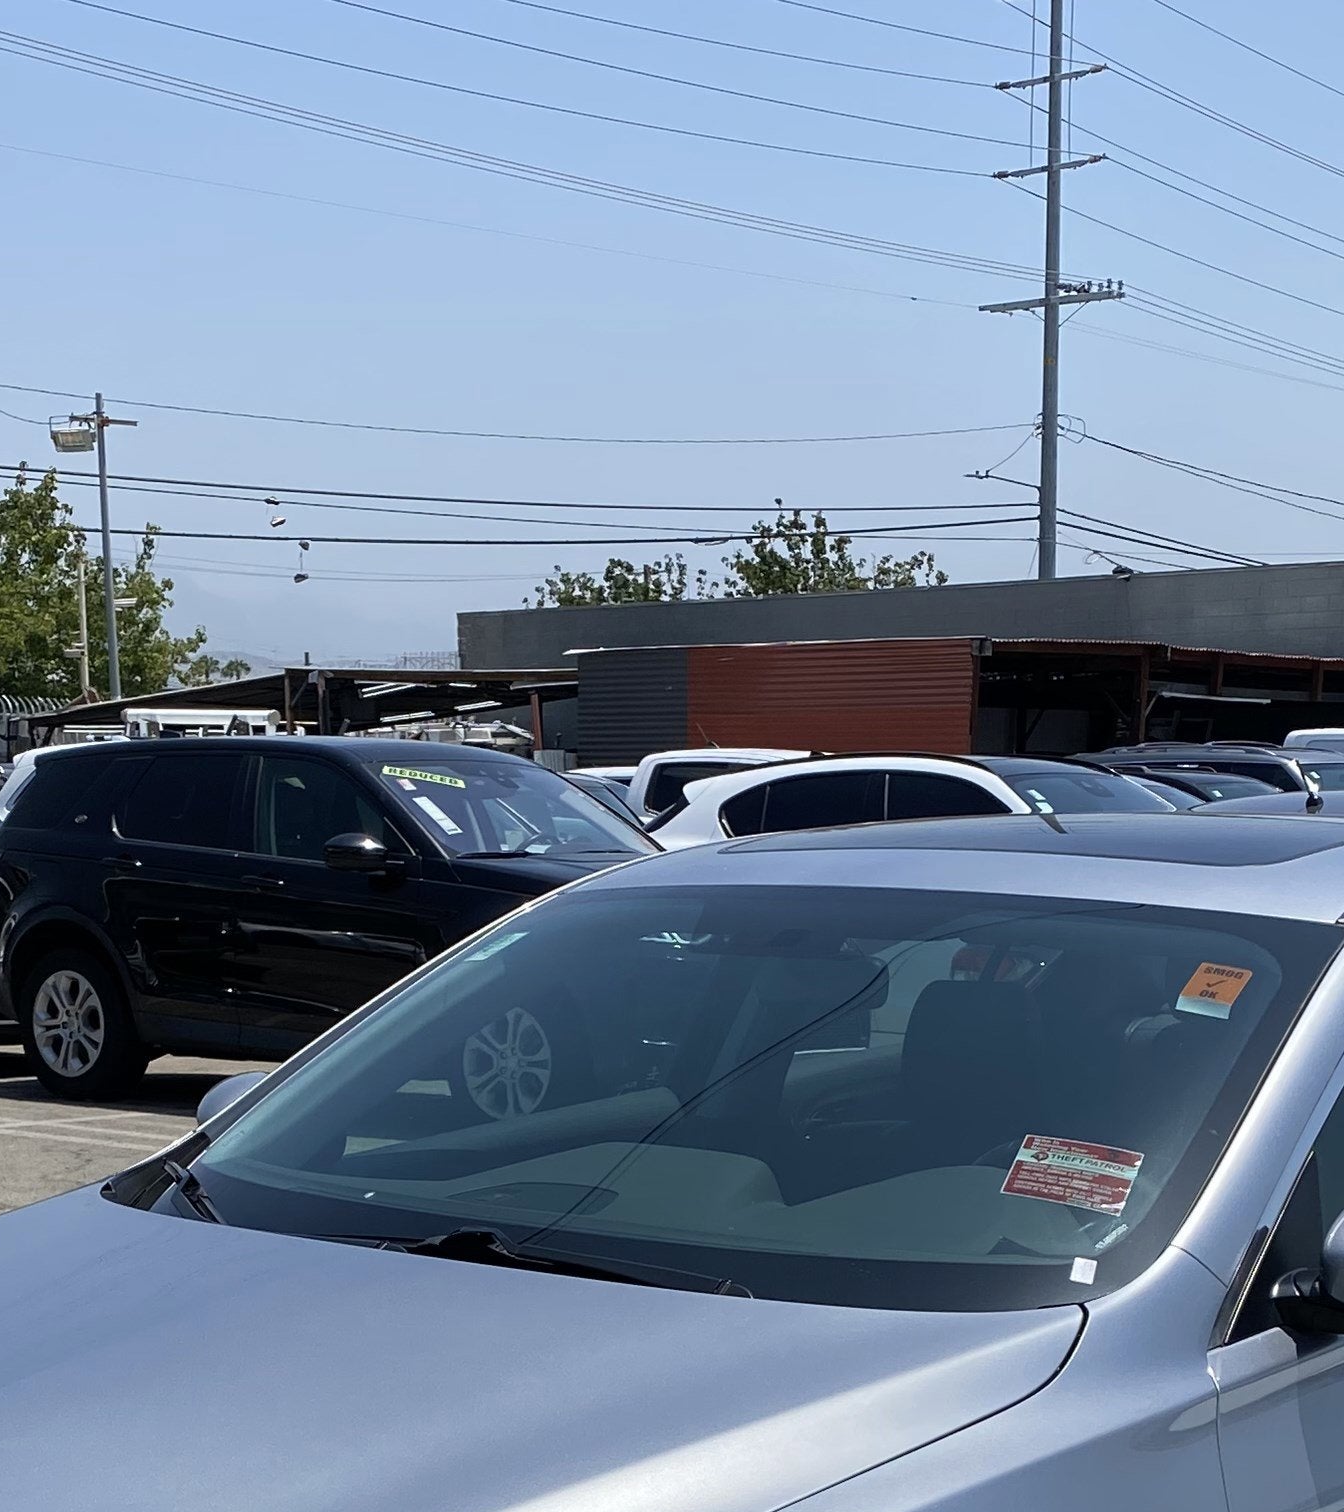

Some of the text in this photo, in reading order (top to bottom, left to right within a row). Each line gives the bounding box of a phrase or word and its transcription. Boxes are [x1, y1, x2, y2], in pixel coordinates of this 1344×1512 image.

[388, 767, 458, 785] REDUCED
[1203, 966, 1244, 979] SMOG
[1199, 989, 1219, 999] OK
